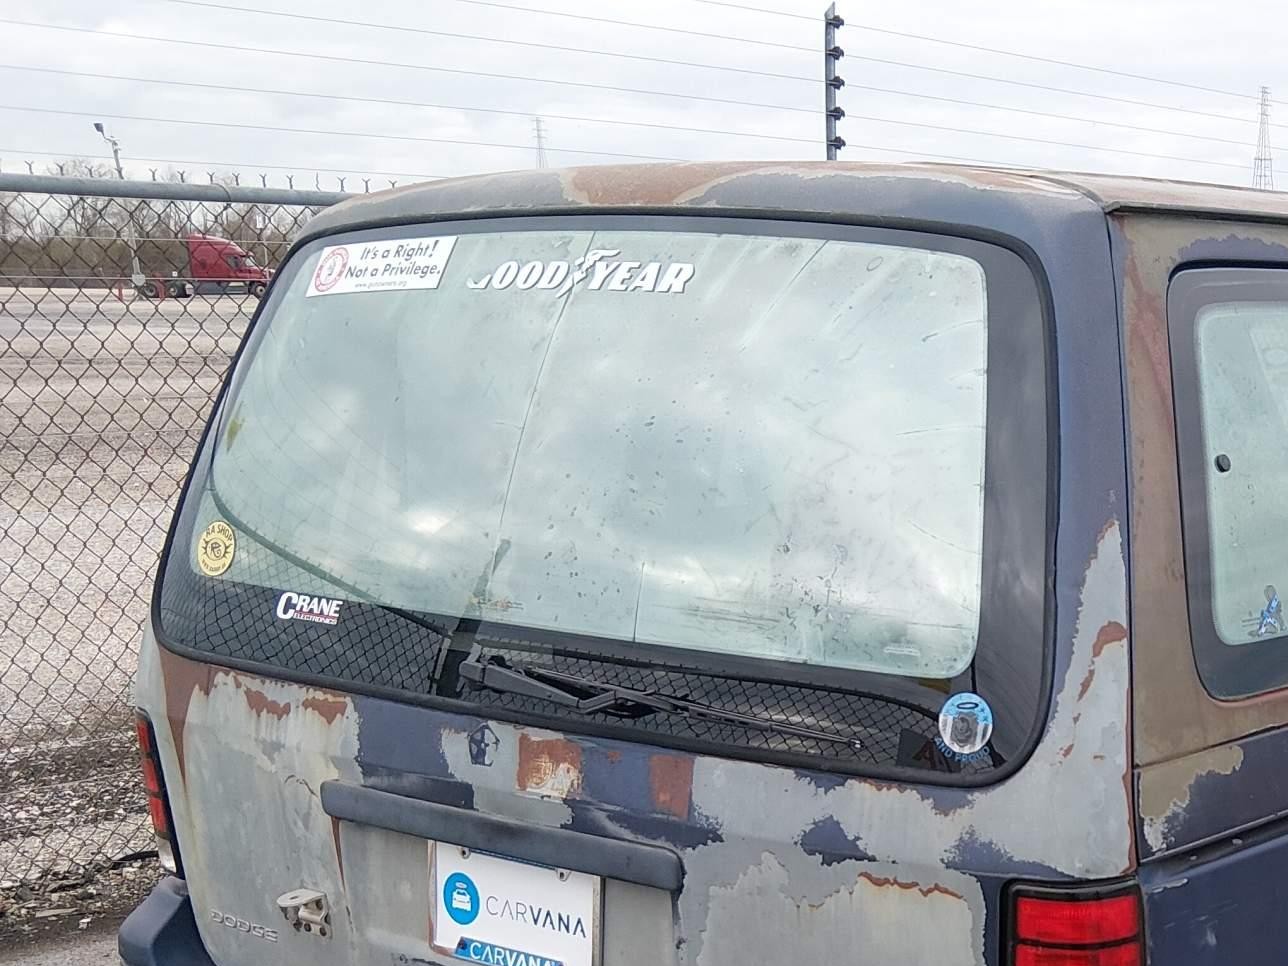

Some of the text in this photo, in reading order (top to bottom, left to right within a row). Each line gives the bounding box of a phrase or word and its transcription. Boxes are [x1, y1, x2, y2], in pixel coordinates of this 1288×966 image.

[360, 239, 439, 262] It's a Right!
[345, 261, 441, 279] Not a Privilege.
[276, 591, 344, 620] CRANE
[210, 908, 281, 943] DODGE
[486, 895, 587, 939] CARVANA
